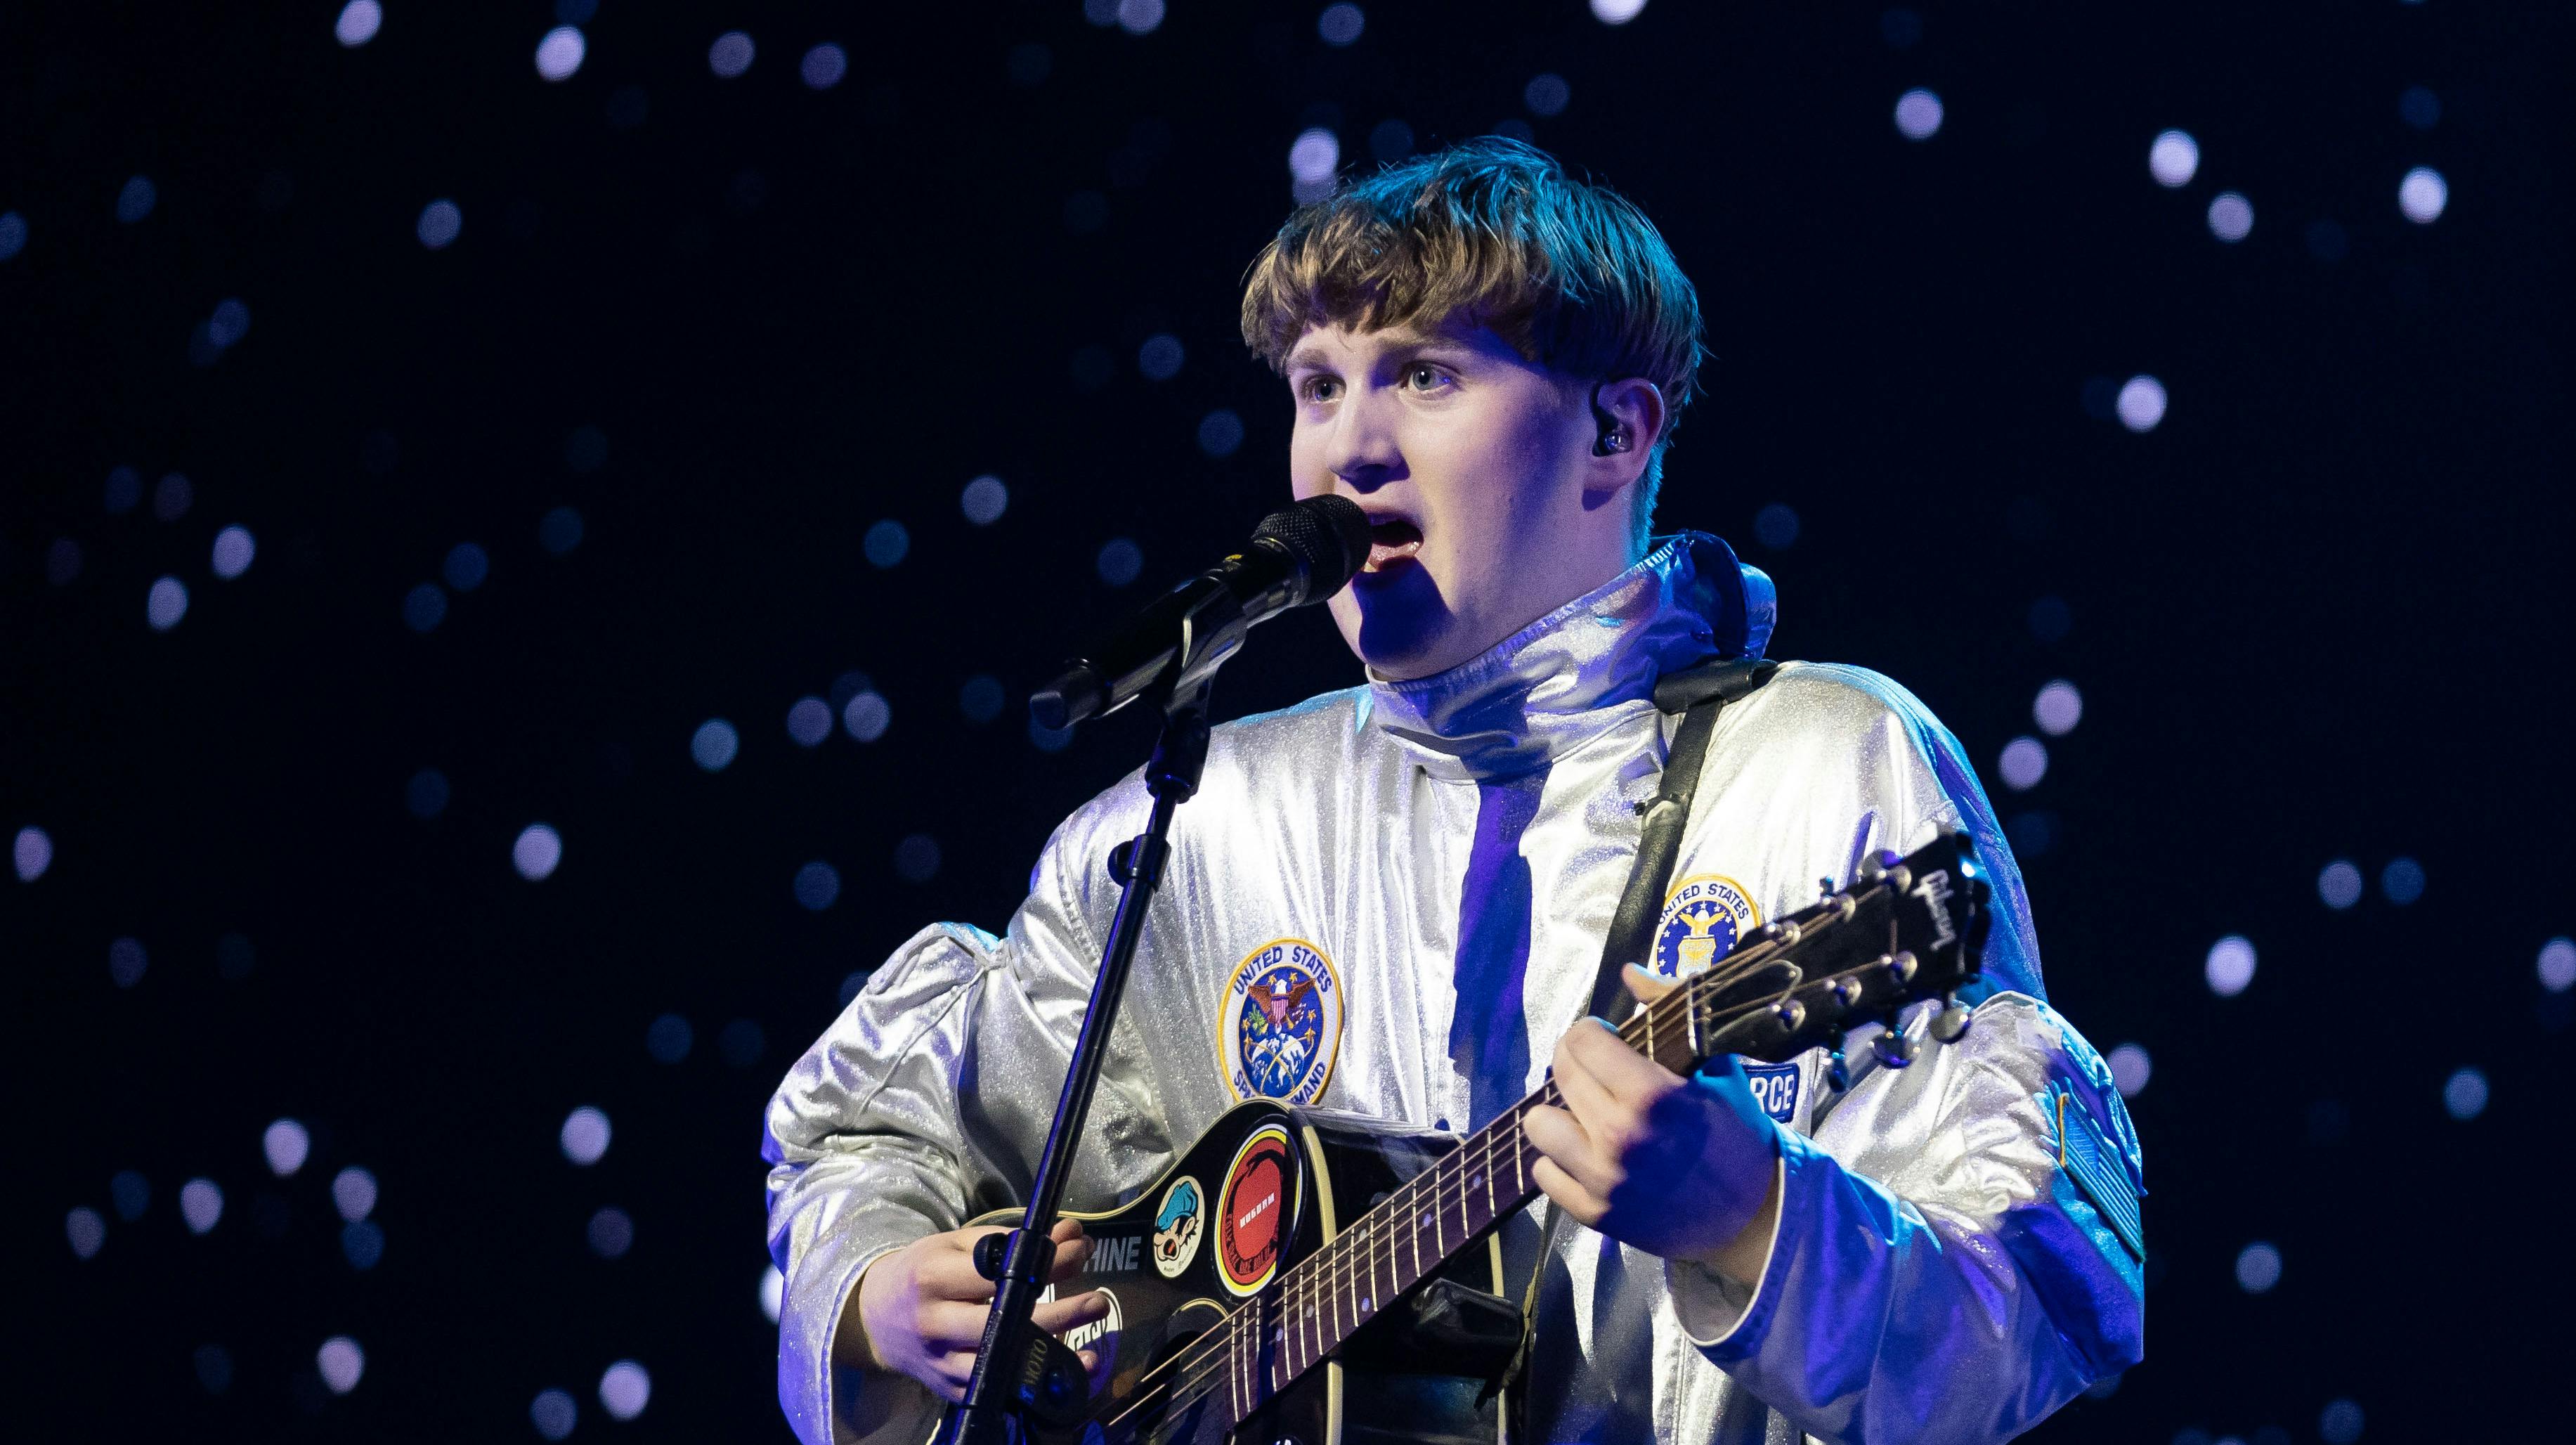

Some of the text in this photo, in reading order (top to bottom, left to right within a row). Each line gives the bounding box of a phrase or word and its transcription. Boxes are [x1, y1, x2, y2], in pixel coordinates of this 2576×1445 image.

[1707, 883, 1749, 920] STATES
[1233, 945, 1332, 995] UNITED STATES
[1750, 1075, 1795, 1113] RCE
[1083, 1236, 1142, 1273] HINE
